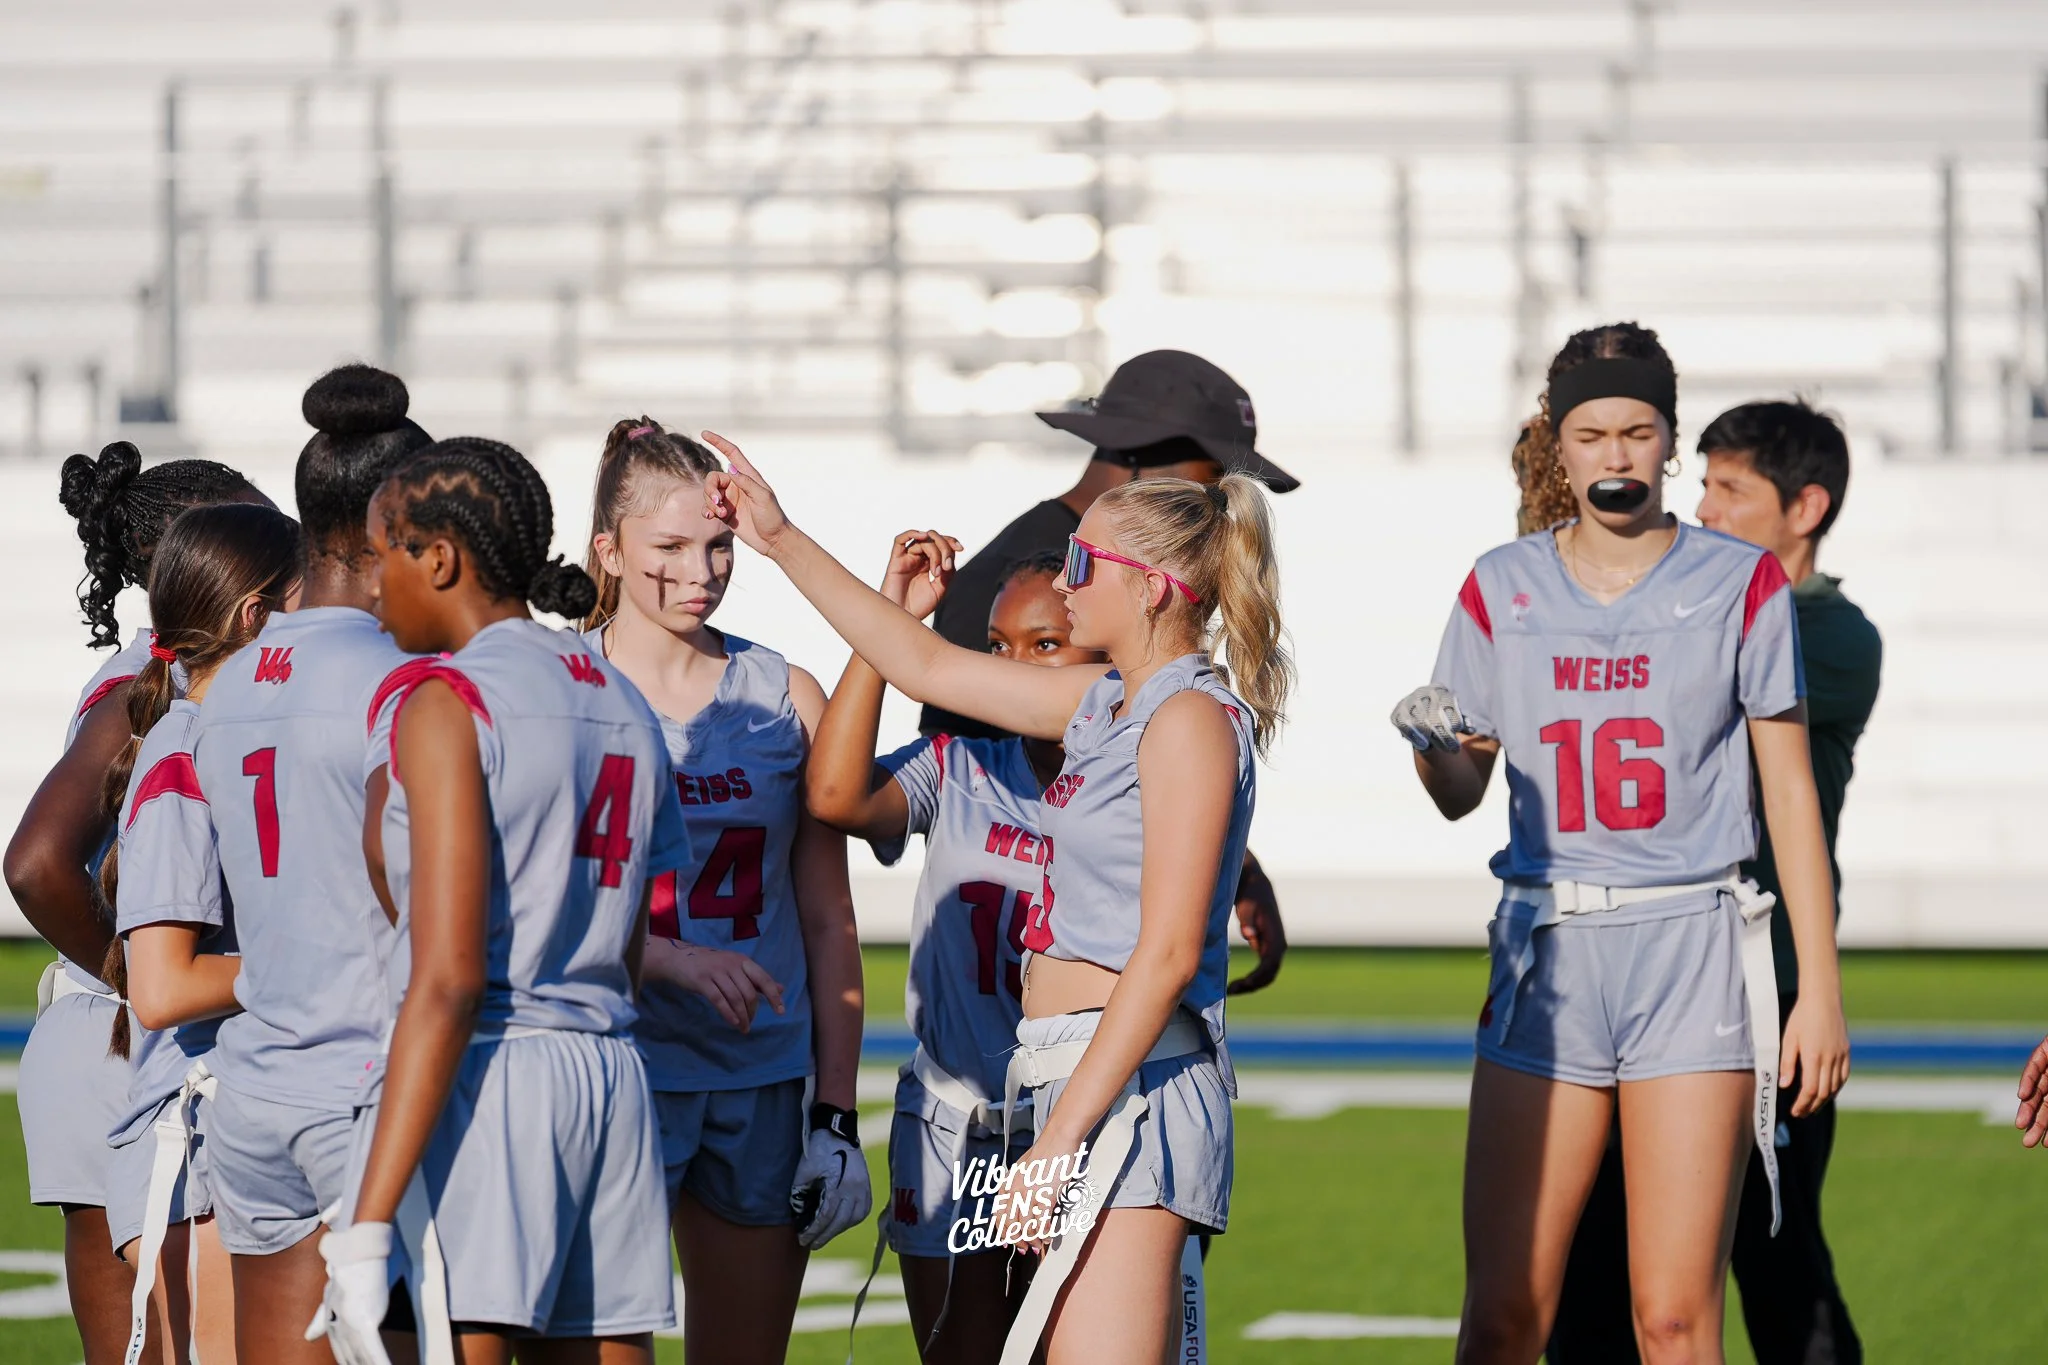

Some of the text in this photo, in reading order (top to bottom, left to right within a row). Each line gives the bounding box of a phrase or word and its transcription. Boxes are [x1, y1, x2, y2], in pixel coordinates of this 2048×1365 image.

[1552, 655, 1650, 692] WEISS
[242, 746, 280, 878] 1
[574, 752, 636, 889] 4
[672, 767, 753, 805] EISS
[1539, 717, 1667, 832] 16
